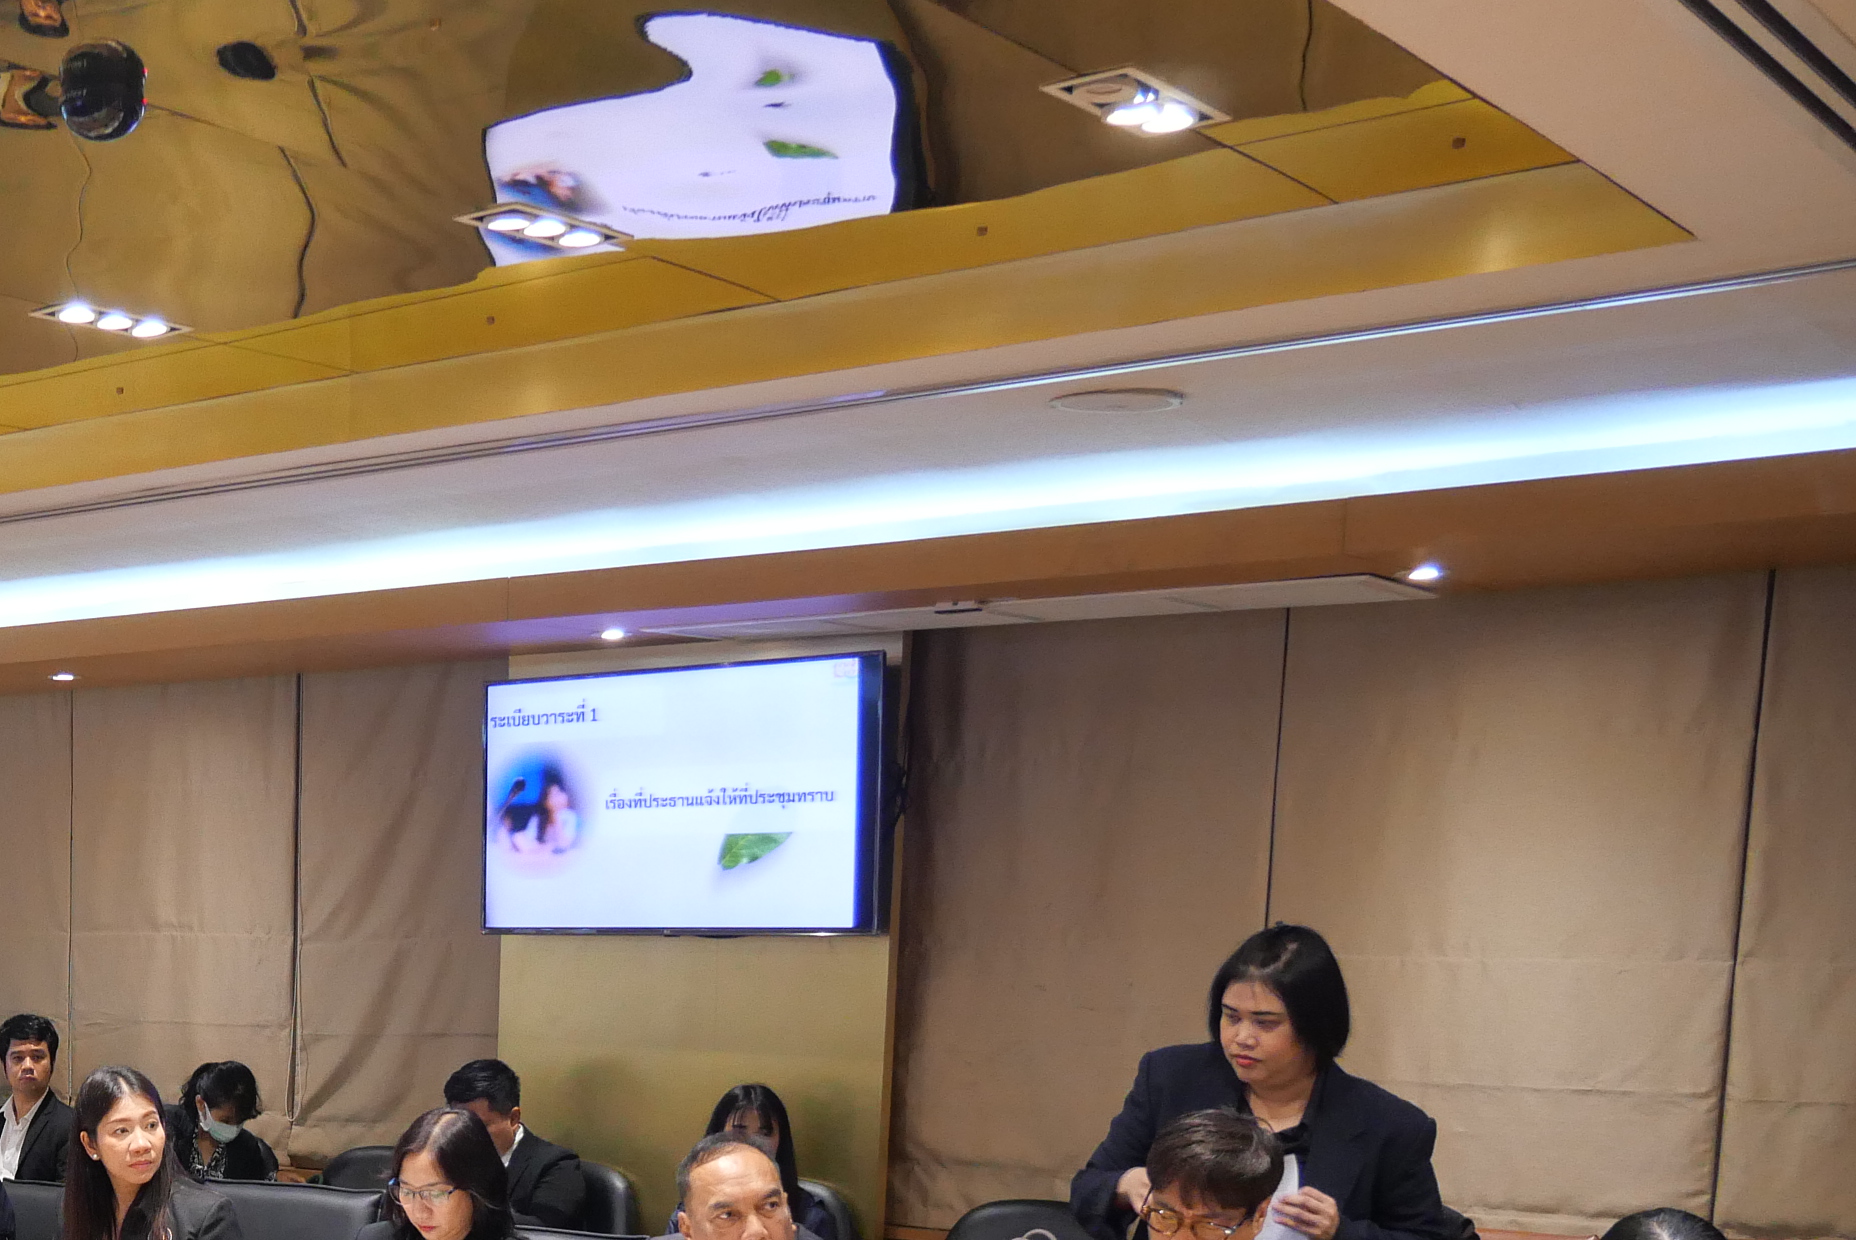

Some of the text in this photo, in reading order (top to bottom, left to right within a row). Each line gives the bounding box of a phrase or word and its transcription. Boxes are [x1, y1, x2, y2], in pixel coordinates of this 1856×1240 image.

[490, 699, 598, 728] ระเบียบวาระที่ 1
[605, 783, 834, 810] เรื่องที่ประธานแจ้งให้ที่ประชุมทราบ
